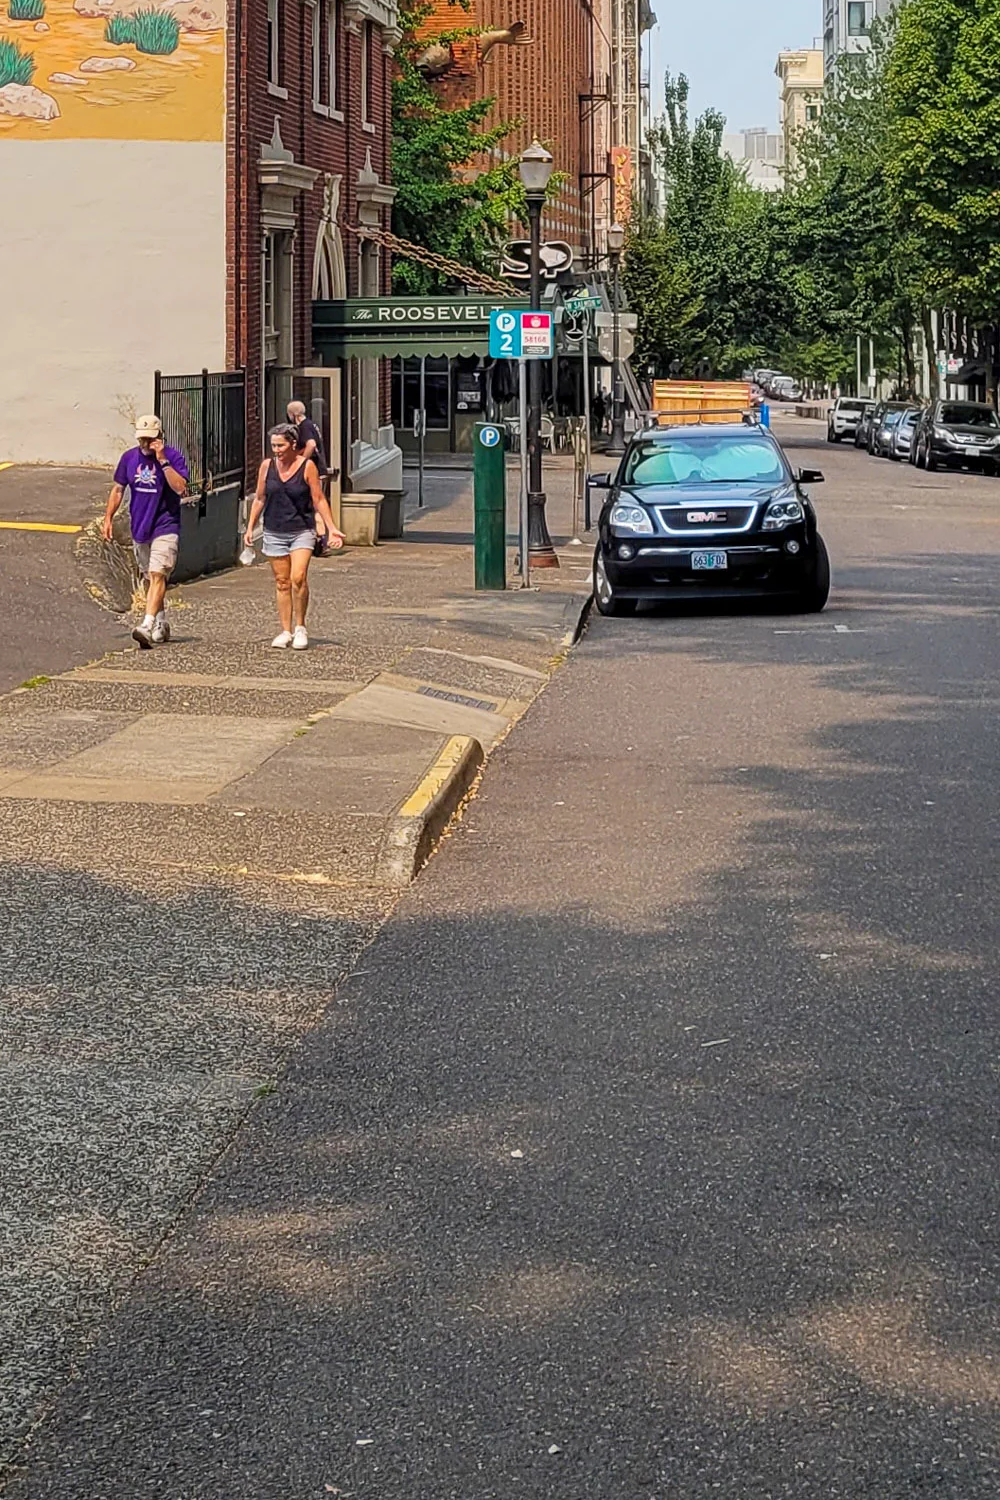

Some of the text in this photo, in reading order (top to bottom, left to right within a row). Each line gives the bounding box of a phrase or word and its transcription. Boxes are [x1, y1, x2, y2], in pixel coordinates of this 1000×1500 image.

[352, 306, 504, 321] The ROOSEVELT
[502, 316, 512, 329] P
[500, 334, 513, 351] 2
[485, 430, 495, 444] P
[687, 512, 727, 523] GMC
